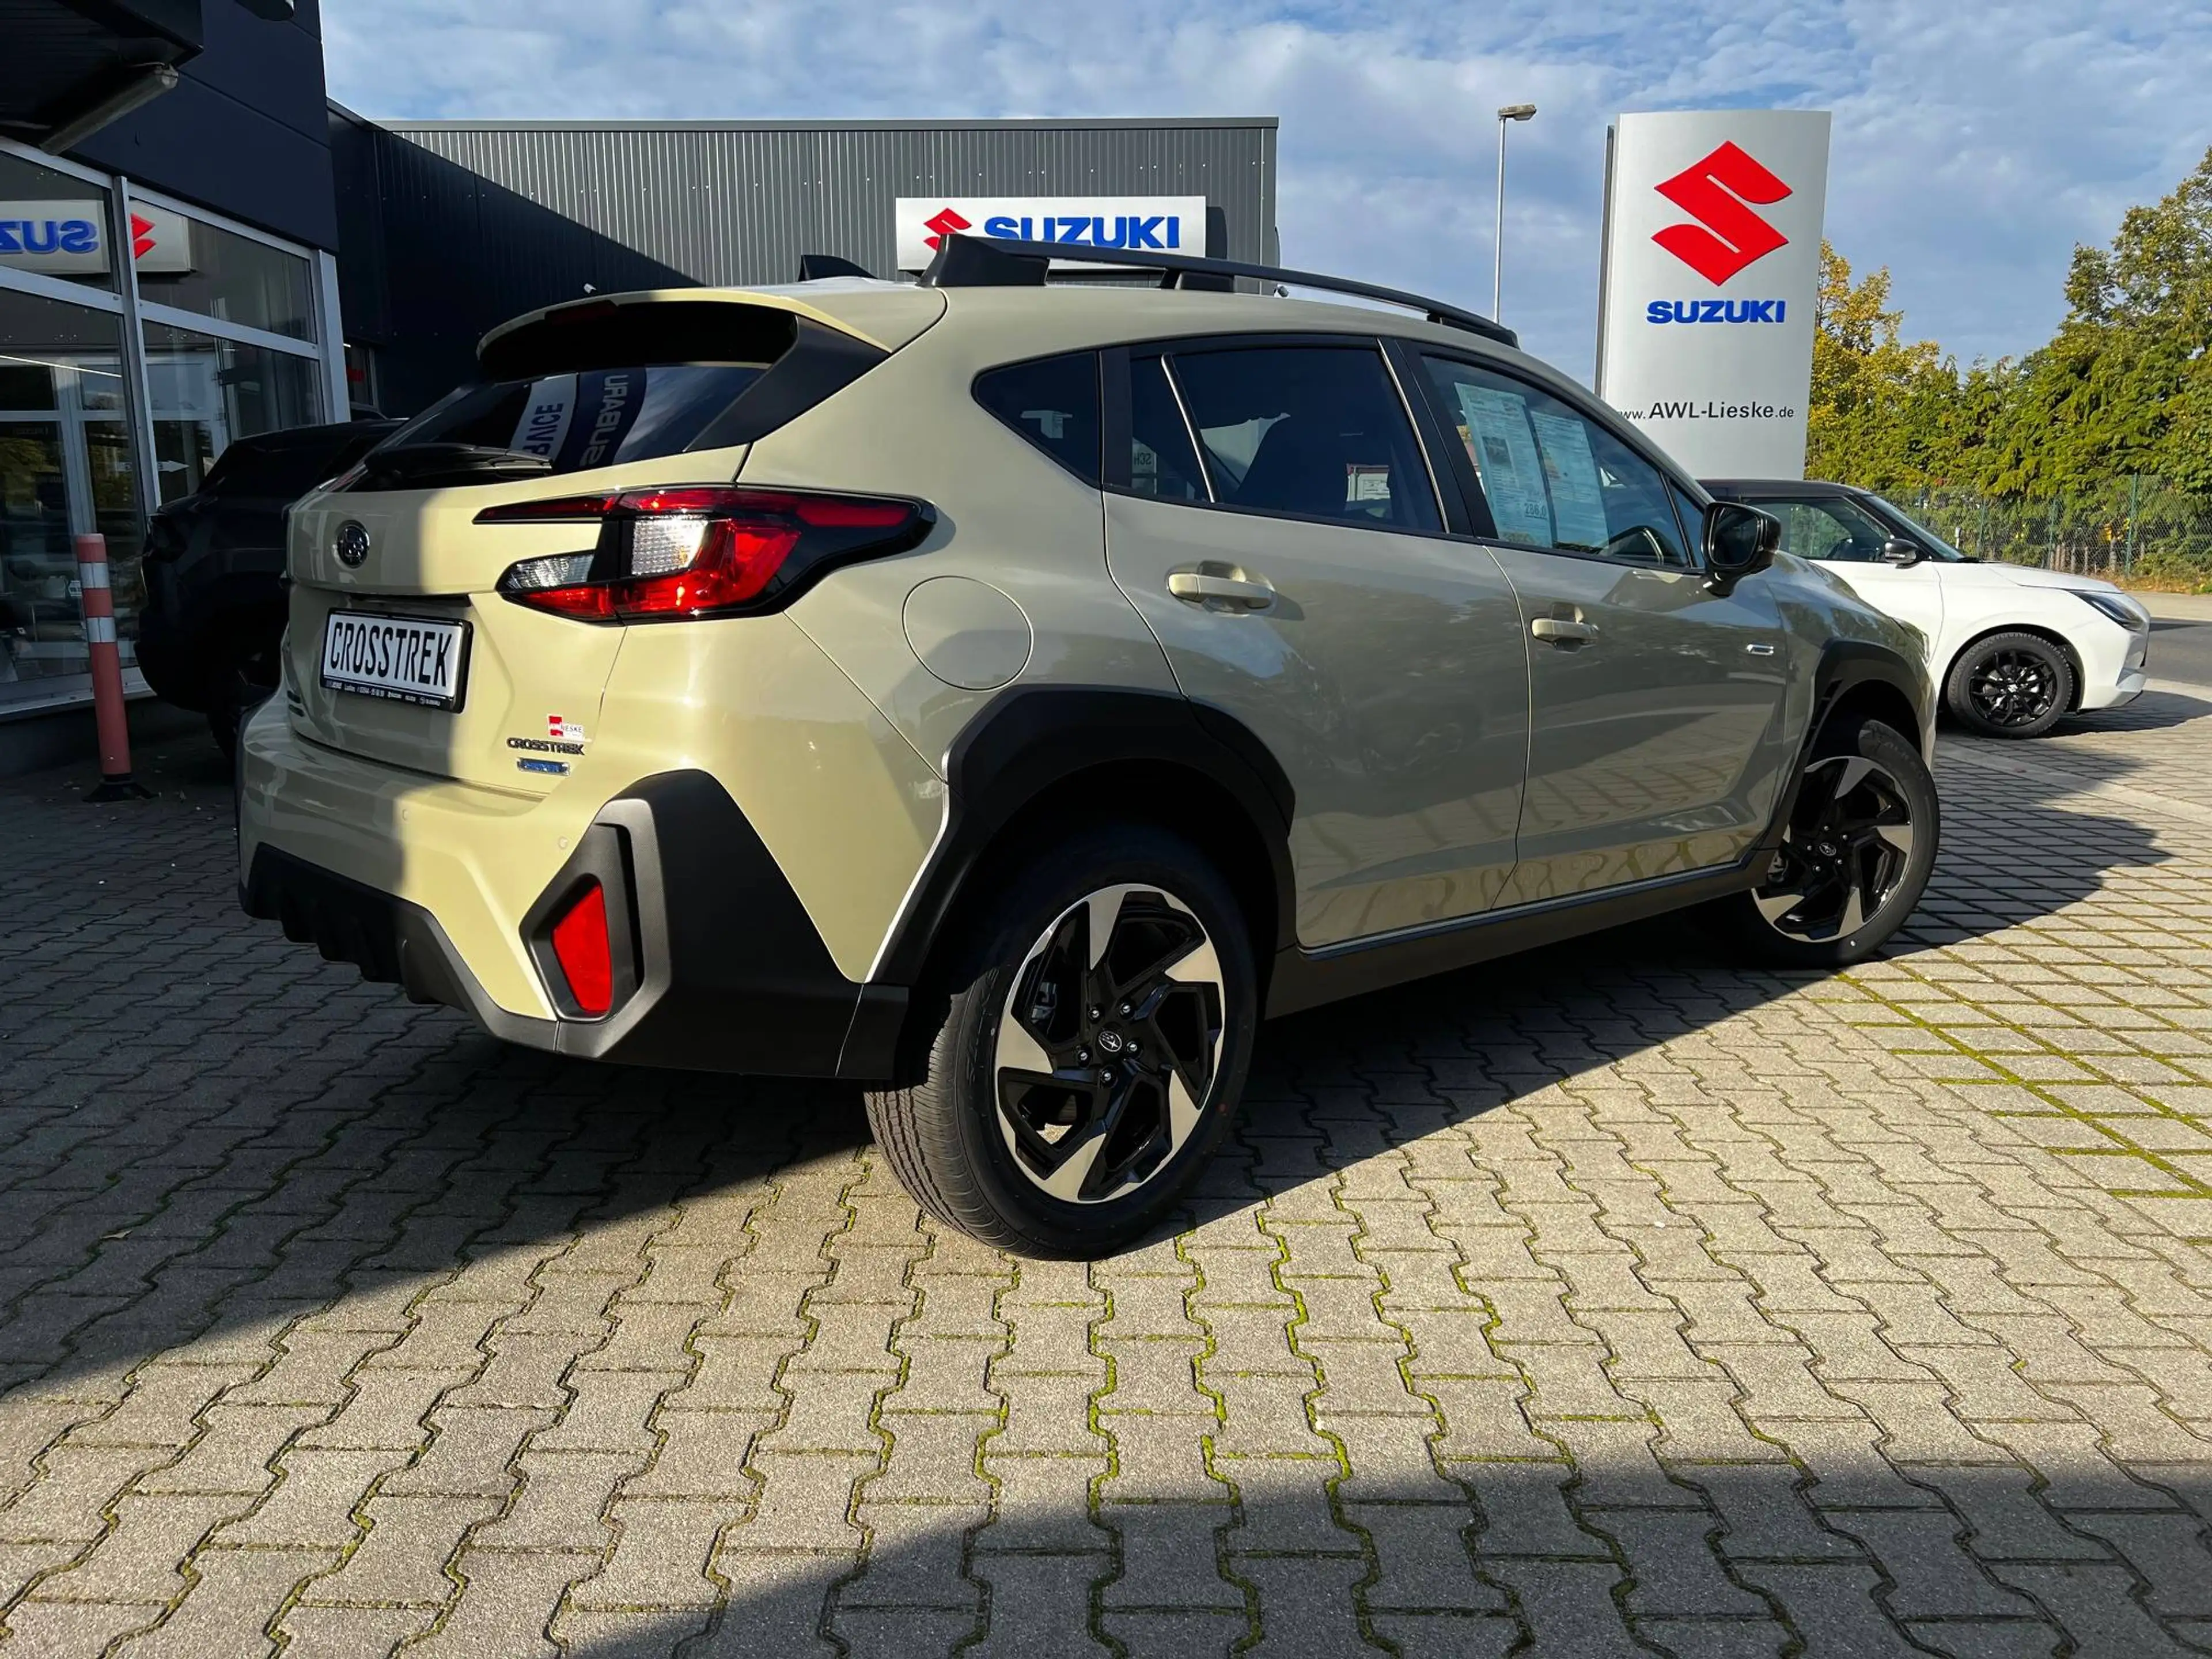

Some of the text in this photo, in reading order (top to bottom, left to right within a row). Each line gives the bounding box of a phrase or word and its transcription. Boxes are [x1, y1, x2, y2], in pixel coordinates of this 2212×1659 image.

[984, 216, 1180, 249] SUZUKI
[1646, 300, 1786, 324] SUZUKI
[1620, 402, 1794, 419] ww.AWL-Lieske.de
[329, 621, 453, 688] CROSSTREK
[506, 737, 585, 756] CROSSTREK
